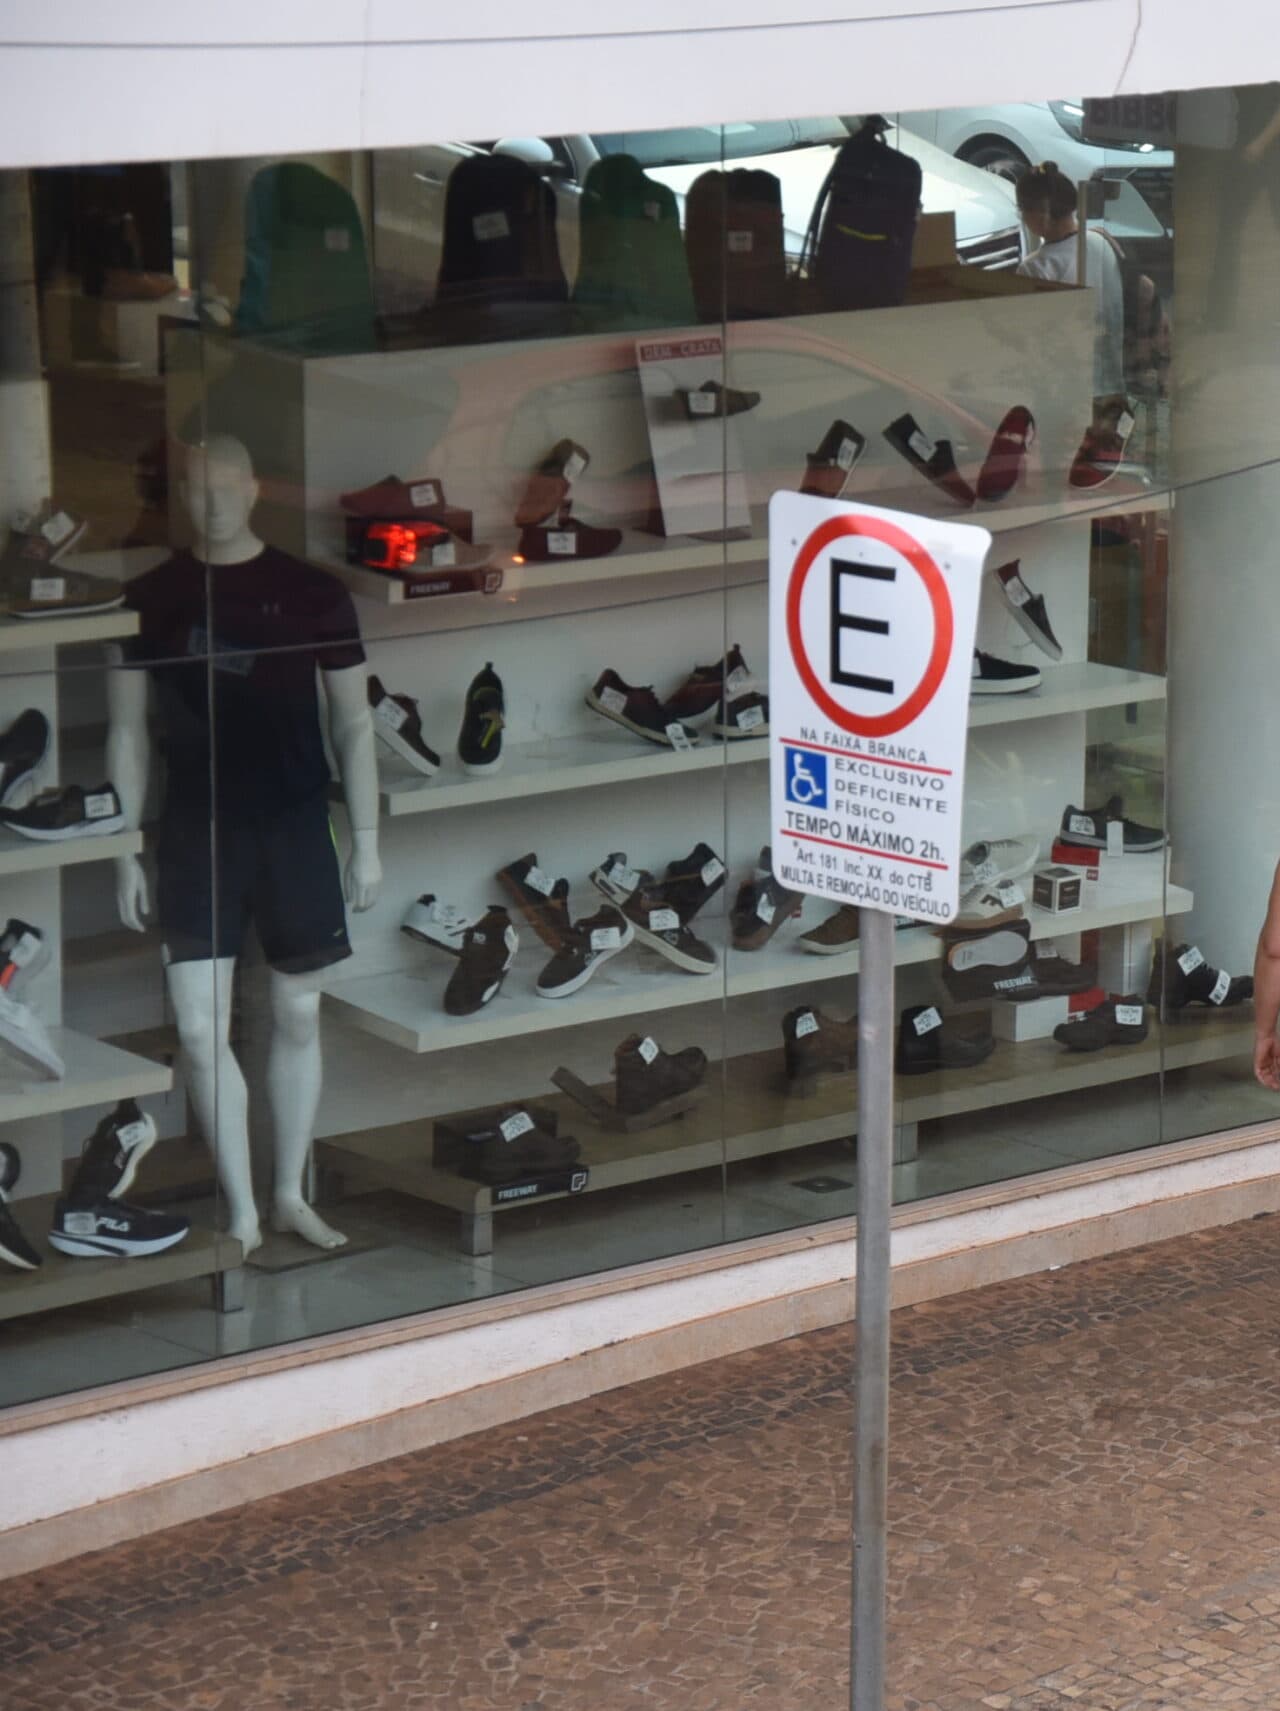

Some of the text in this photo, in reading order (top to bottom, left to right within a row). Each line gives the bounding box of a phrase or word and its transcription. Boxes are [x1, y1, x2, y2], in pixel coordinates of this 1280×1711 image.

[830, 557, 897, 694] E
[799, 727, 928, 765] NA FAIXA BRANCA
[834, 758, 945, 792] EXCLUSIVO
[834, 779, 948, 814] DEFICIENTE
[834, 798, 896, 825] FÍSICO
[785, 810, 945, 862] TEMPO MÁXIMO 2h.
[796, 848, 816, 865] Art.
[820, 853, 838, 871] 181
[867, 865, 882, 880] XX
[889, 871, 904, 885] do
[907, 873, 933, 892] CTB
[780, 864, 951, 918] MULTA E REMOÇÃO DO VEÍCULO
[497, 1184, 539, 1201] FREEWAY
[95, 1216, 130, 1232] FILA
